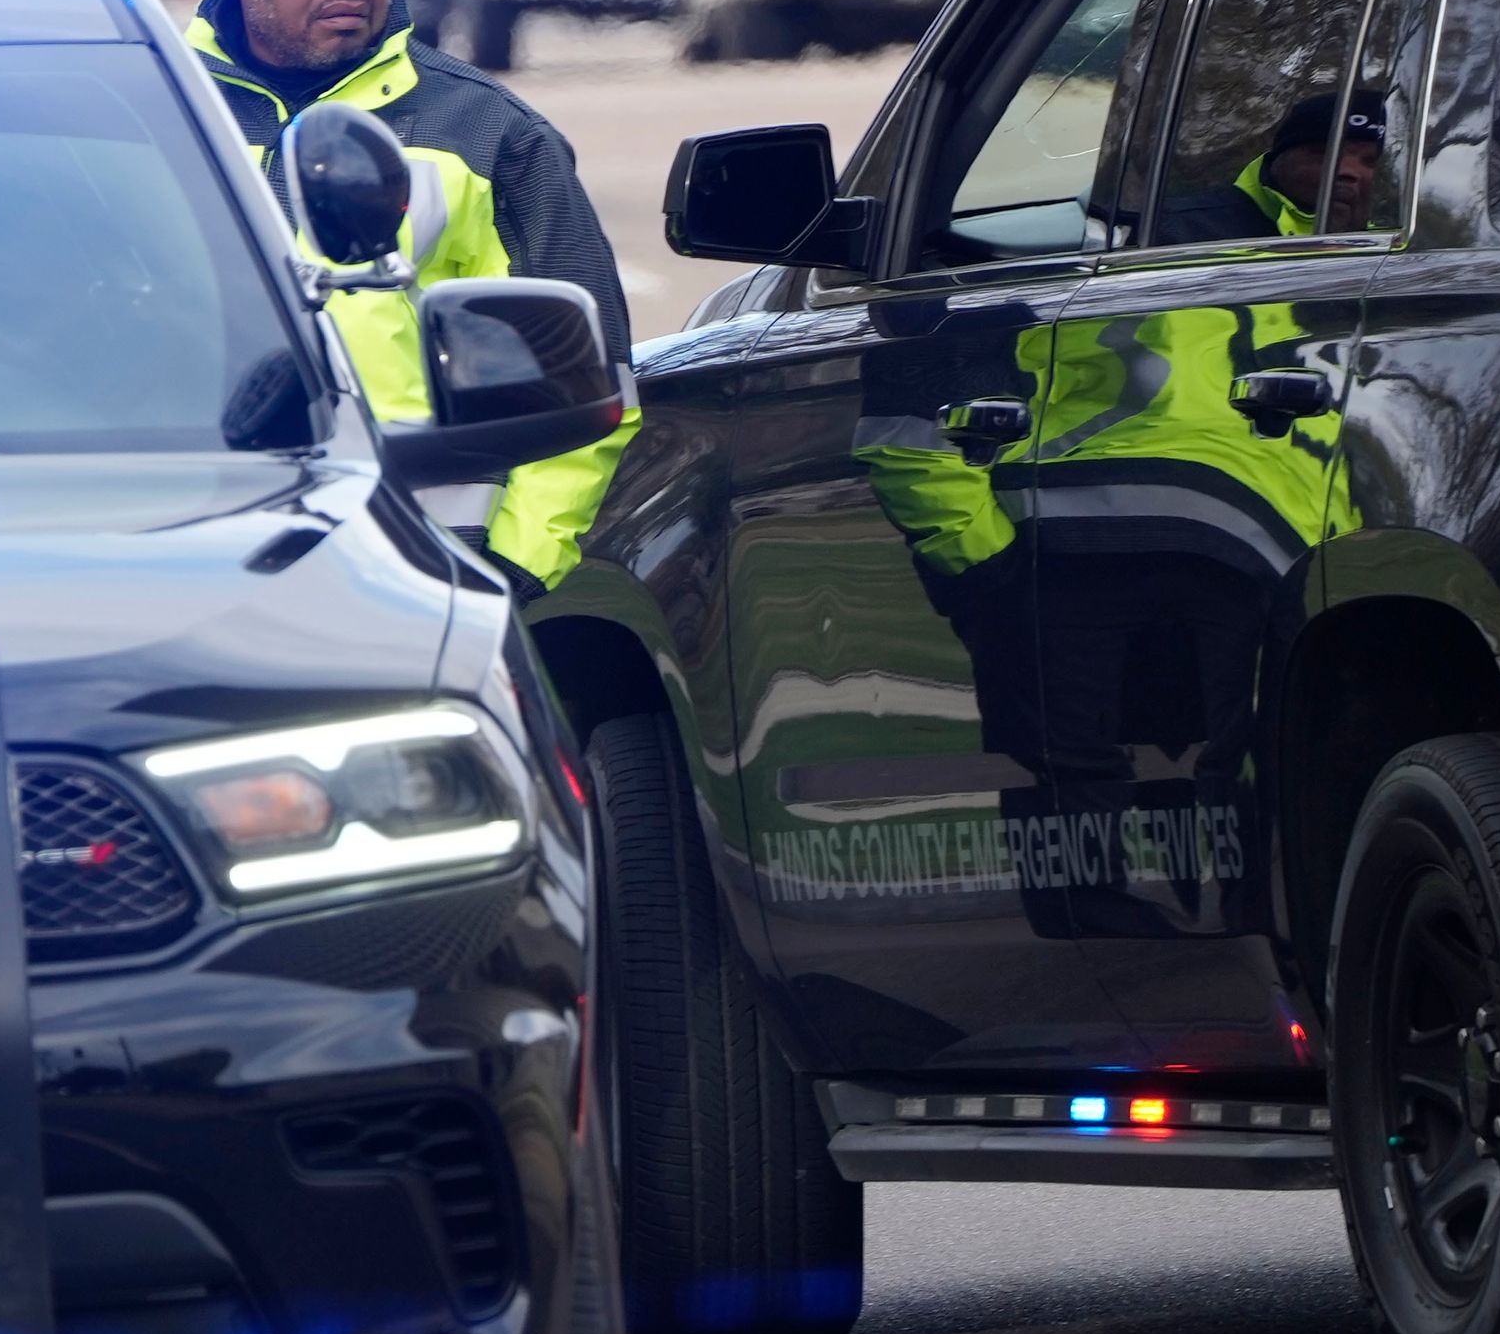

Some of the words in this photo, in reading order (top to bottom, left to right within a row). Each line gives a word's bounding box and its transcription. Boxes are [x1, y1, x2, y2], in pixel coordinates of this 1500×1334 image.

[762, 828, 846, 903] HINDS
[848, 822, 949, 898] COUNTY
[954, 811, 1114, 893] EMERGENCY
[1119, 805, 1245, 886] SERVICES
